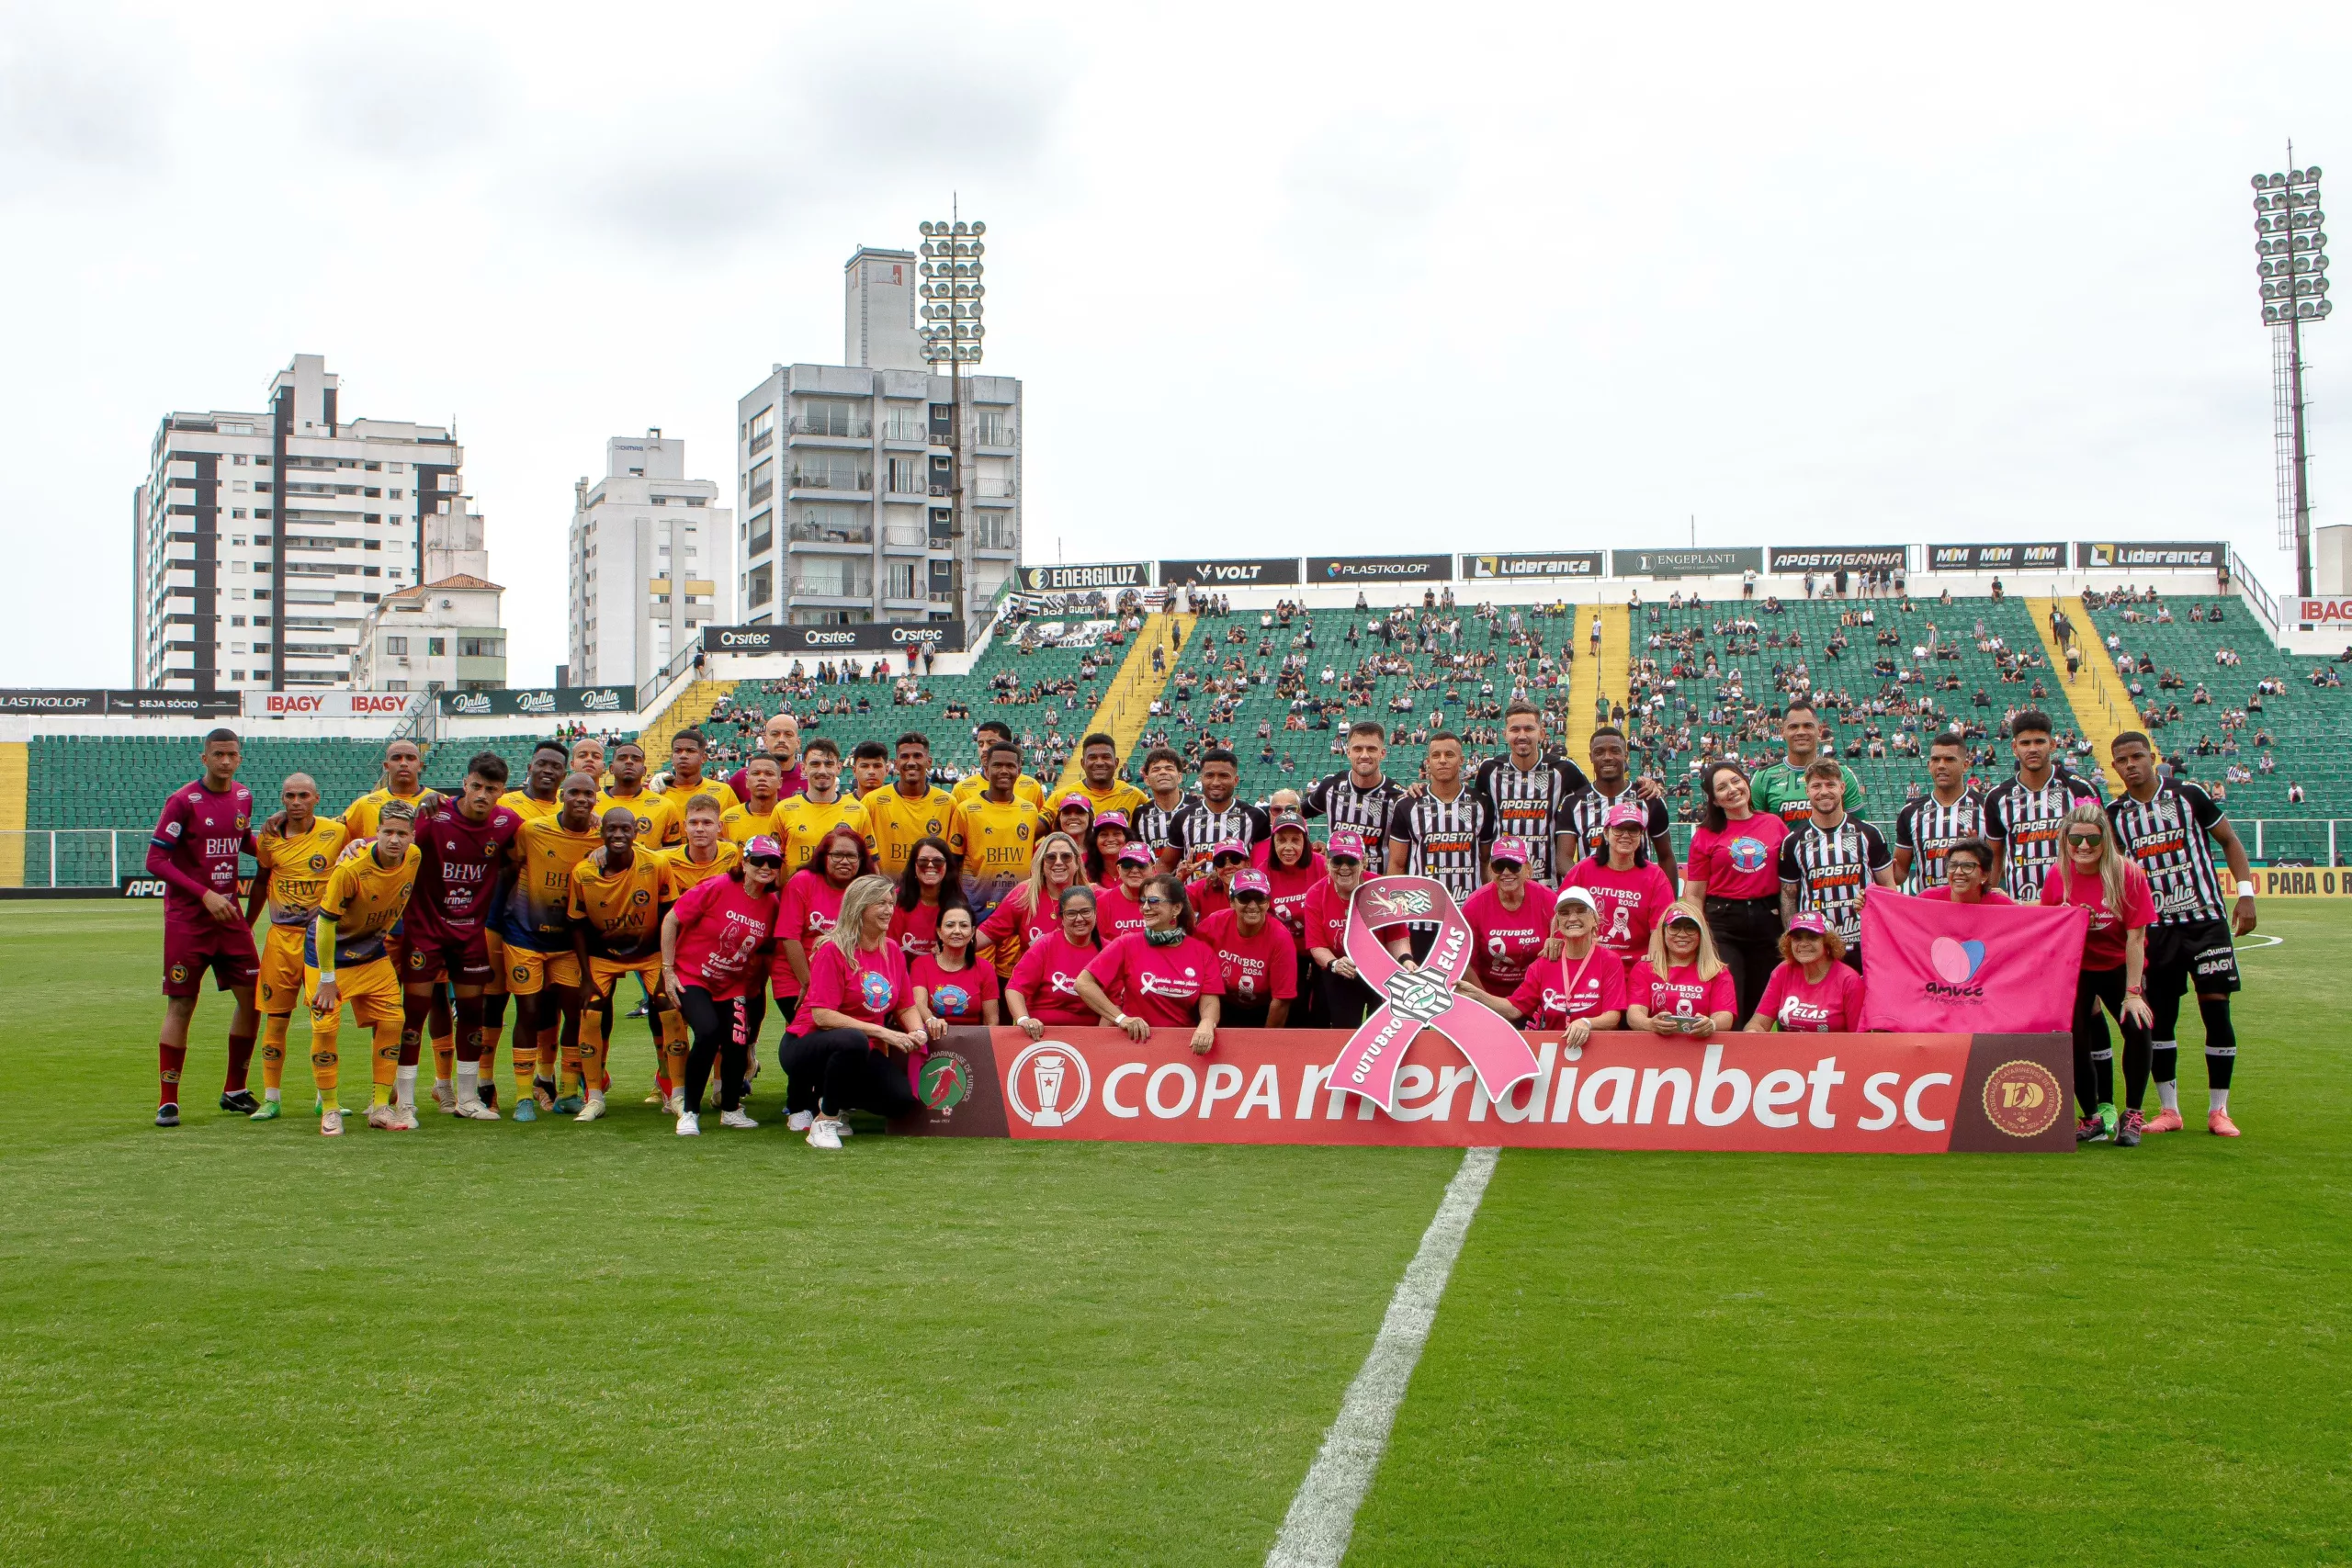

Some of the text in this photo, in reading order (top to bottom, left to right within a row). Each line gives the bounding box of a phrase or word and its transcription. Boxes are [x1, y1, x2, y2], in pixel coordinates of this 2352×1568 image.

[1657, 553, 1736, 564] ENGEPLANTI
[2118, 548, 2212, 566] Liderança
[1216, 565, 1261, 580] VOLT
[1342, 564, 1428, 575] PLASTKOLOR
[1500, 559, 1590, 576] Liderança
[1052, 565, 1136, 587] ENERGILUZ
[720, 631, 770, 645] Orsitec
[805, 630, 855, 644] Orsitec
[891, 627, 943, 642] Orsitec
[139, 698, 198, 708] SEJA SÓCIO
[266, 694, 325, 714] IBAGY
[351, 694, 411, 714] IBAGY
[452, 693, 492, 712] Dalla
[516, 691, 556, 710] Dalla
[581, 689, 620, 708] Dalla
[1499, 800, 1549, 810] APOSTA
[1502, 809, 1546, 819] GANHA
[1334, 821, 1383, 838] APOSTA
[1424, 832, 1475, 843] APOSTA
[2132, 828, 2185, 849] APOSTA
[206, 838, 243, 855] BHW
[1428, 842, 1472, 852] GANHA
[2137, 840, 2184, 859] GANHA
[986, 847, 1024, 863] BHW
[442, 862, 488, 880] BHW
[1434, 865, 1475, 875] Liderança
[1808, 863, 1861, 880] APOSTA
[1813, 874, 1860, 889] GANHA
[2267, 872, 2317, 895] PARA
[2323, 872, 2335, 895] O
[1589, 886, 1642, 901] OUTUBRO
[1618, 899, 1639, 908] ROSA
[2163, 902, 2199, 915] PURO MALTE
[726, 909, 766, 931] OUTUBRO
[749, 927, 764, 937] ROSA
[1489, 929, 1534, 937] OUTUBRO
[1518, 936, 1541, 944] ROSA
[1436, 926, 1465, 971] ELAS
[1218, 950, 1265, 969] OUTUBRO
[2198, 956, 2233, 975] IBAGY
[1243, 967, 1263, 976] ROSA
[1679, 991, 1702, 999] ROSA
[1792, 1008, 1829, 1020] ELAS
[732, 1003, 747, 1045] ELAS
[1351, 1018, 1403, 1084] OUTUBRO
[1999, 1066, 2043, 1080] CATARINENSE
[2041, 1077, 2051, 1087] DE
[1102, 1062, 1283, 1120] COPA
[1856, 1071, 1952, 1132] SC
[2044, 1087, 2055, 1114] FUTEBOL
